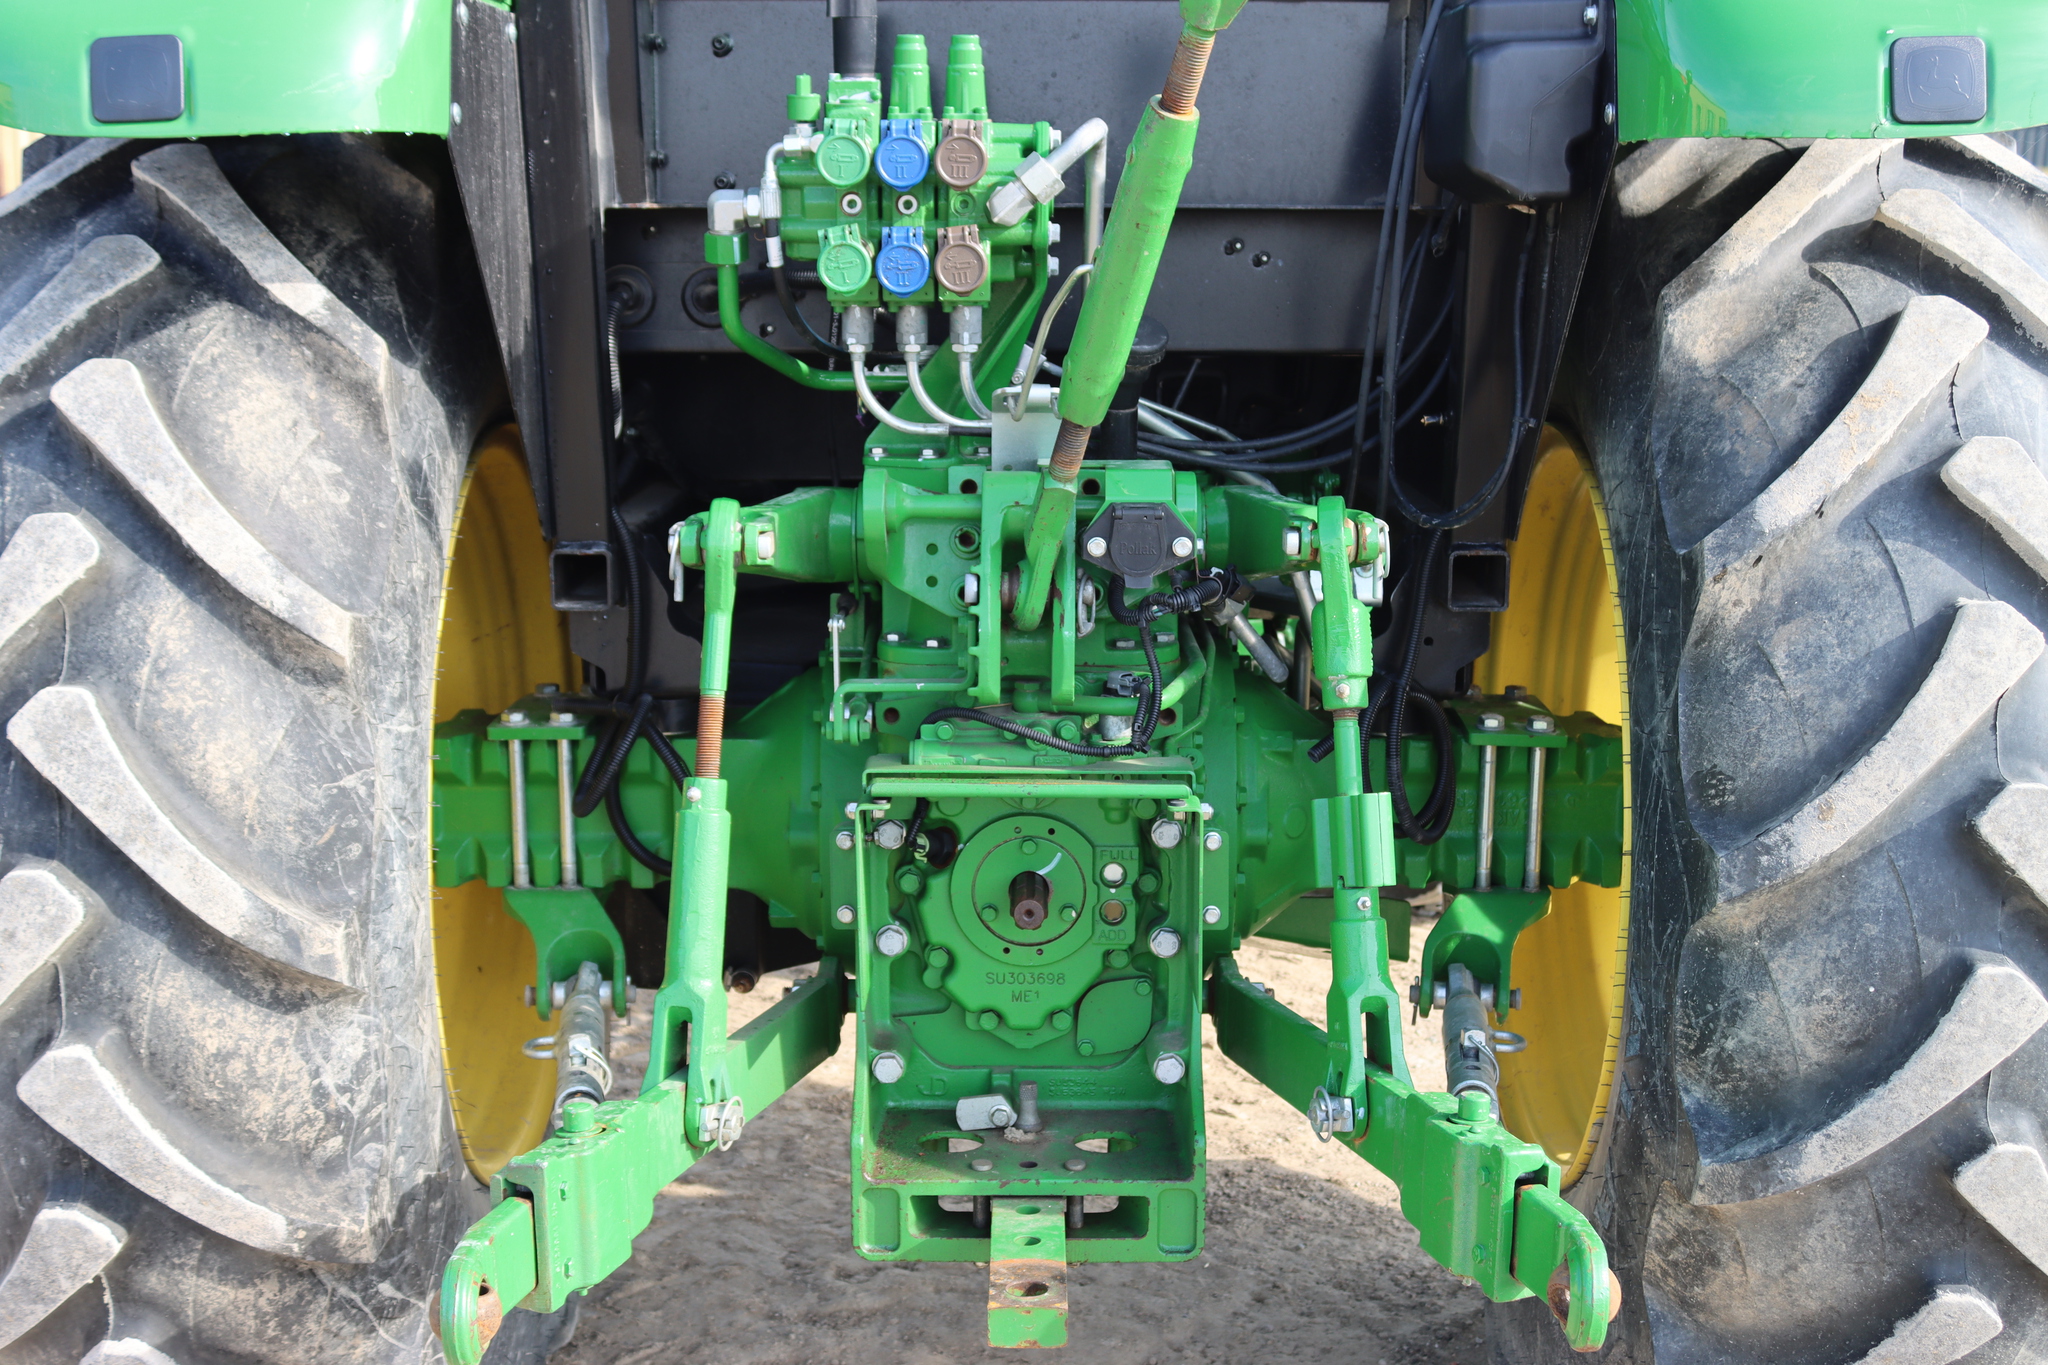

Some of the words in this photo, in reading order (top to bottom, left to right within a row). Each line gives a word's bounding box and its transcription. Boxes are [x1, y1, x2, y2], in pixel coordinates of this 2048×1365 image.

[894, 164, 908, 178] II
[950, 165, 969, 178] III
[952, 271, 971, 284] III
[1119, 541, 1157, 555] Pollak
[1100, 849, 1137, 860] FULL
[1099, 929, 1127, 941] ADD
[985, 972, 1066, 985] SU303698
[1011, 990, 1040, 1003] ME1
